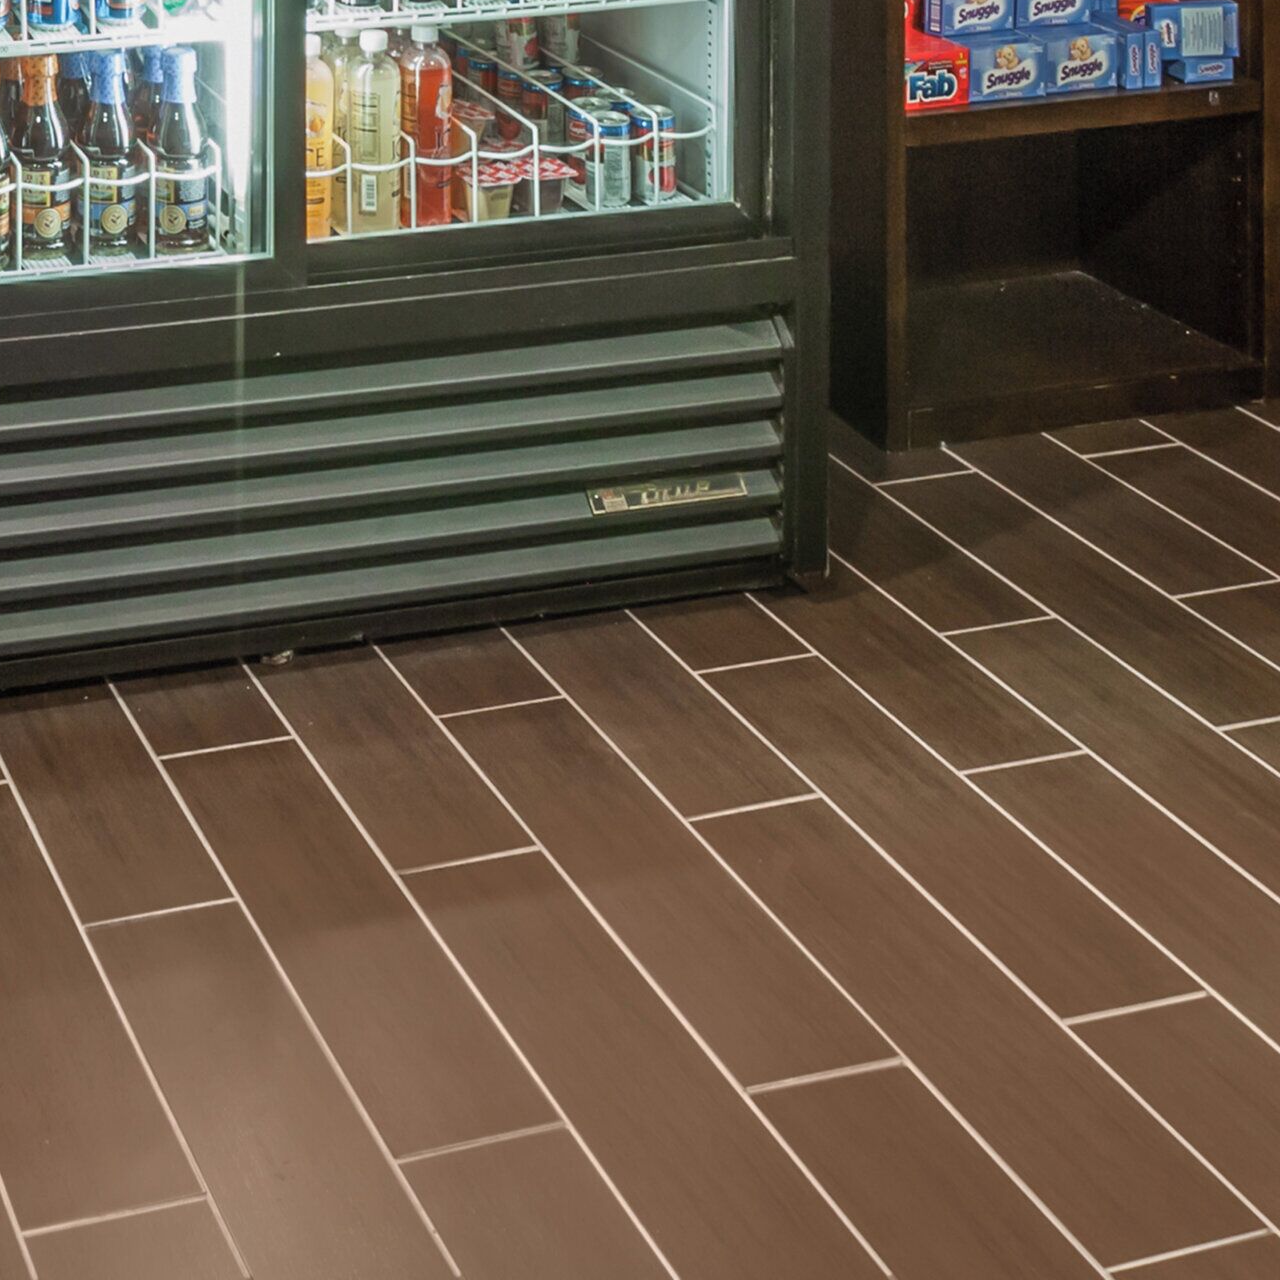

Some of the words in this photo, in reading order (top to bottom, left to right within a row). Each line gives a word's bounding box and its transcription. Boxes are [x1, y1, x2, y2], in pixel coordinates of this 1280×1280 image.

[958, 2, 1000, 24] Snuggle
[986, 68, 1032, 90] Snuggle
[1060, 58, 1104, 81] Snuggle
[908, 68, 957, 103] Fab
